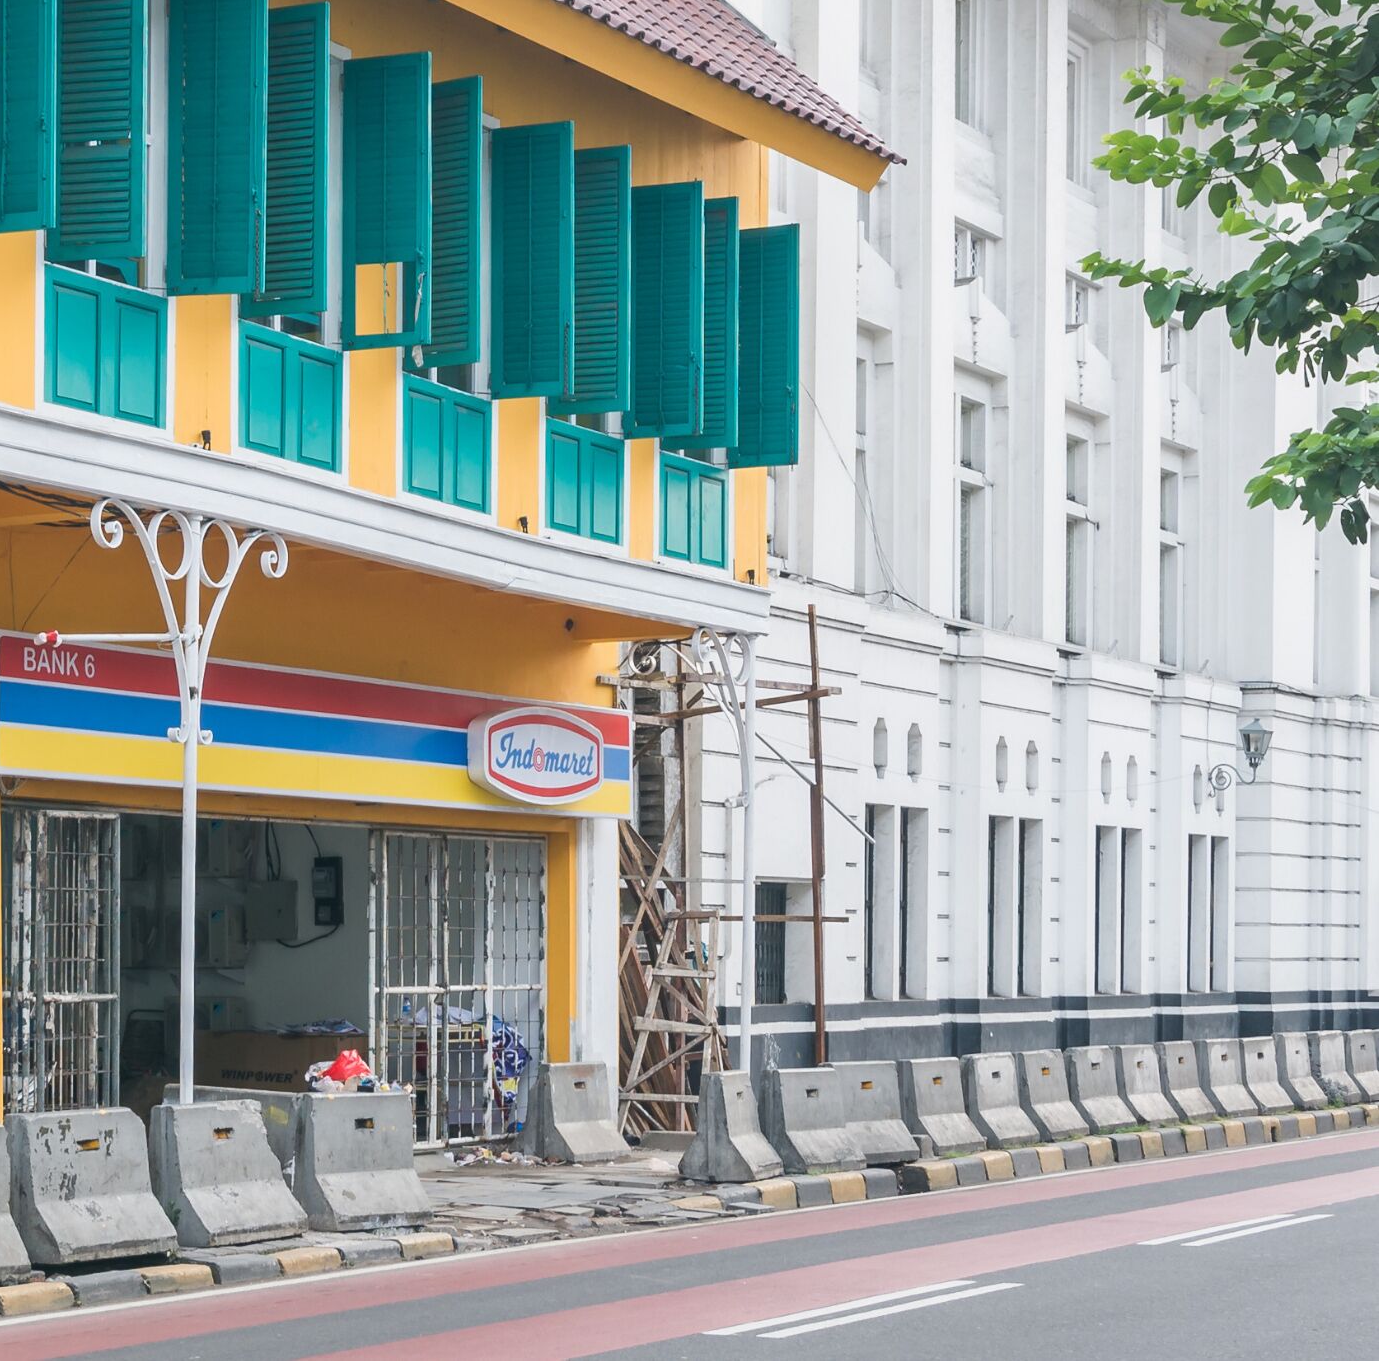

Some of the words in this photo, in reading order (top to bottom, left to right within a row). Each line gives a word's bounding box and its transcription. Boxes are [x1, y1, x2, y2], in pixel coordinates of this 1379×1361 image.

[23, 646, 80, 677] BANK
[84, 653, 96, 679] 6
[495, 731, 594, 777] Indomaret
